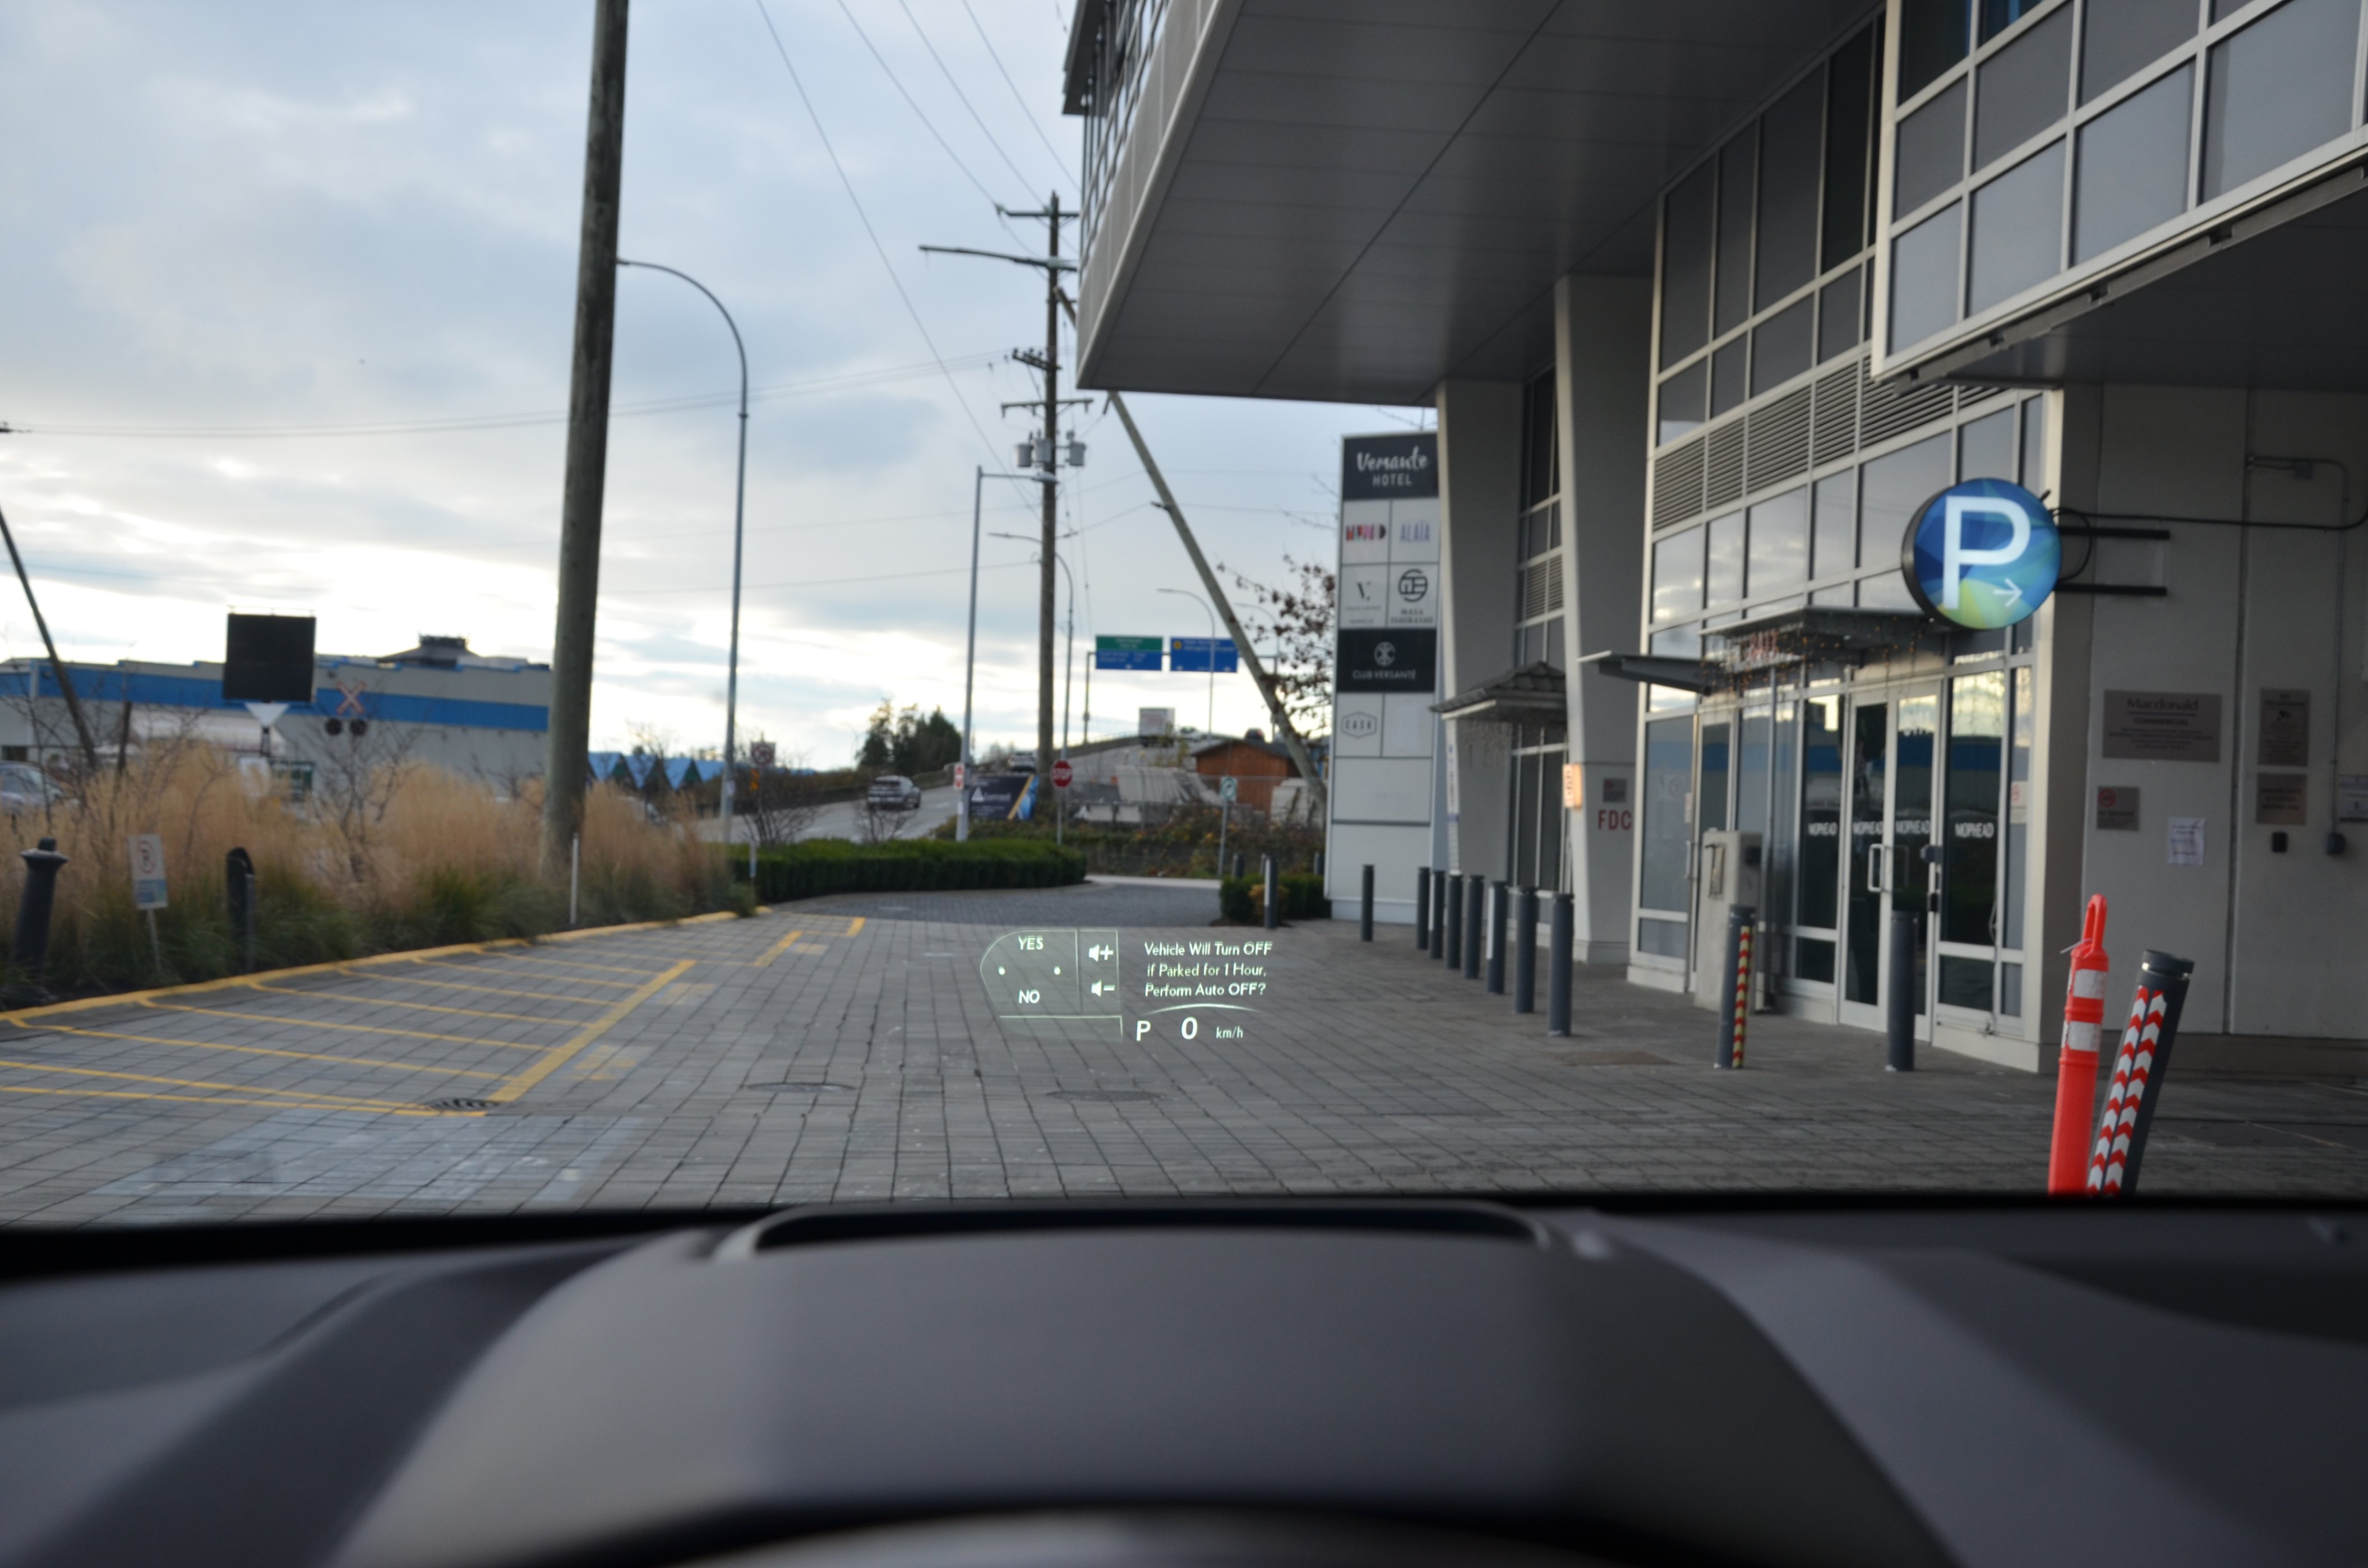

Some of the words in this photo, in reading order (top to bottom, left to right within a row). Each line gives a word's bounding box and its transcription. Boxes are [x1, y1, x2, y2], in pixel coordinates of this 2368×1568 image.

[1372, 473, 1413, 487] HOTEL
[1942, 495, 2031, 610] P
[1352, 670, 1373, 680] CLUB
[2126, 698, 2199, 710] Macdonald
[1346, 719, 1372, 729] CASK
[1051, 767, 1072, 780] STOP
[1598, 809, 1633, 831] FDC
[1018, 936, 1044, 951] YES
[1144, 942, 1185, 956] Vehicle
[1189, 942, 1211, 956] Will
[1214, 942, 1240, 956] Turn
[1243, 941, 1273, 955] OFF
[1147, 963, 1156, 977] if
[1158, 963, 1199, 977] Parked
[1203, 963, 1220, 977] for
[1224, 963, 1229, 976] 1
[1233, 963, 1266, 977] Hour,
[1018, 989, 1041, 1004] NO
[1144, 983, 1192, 997] Perform
[1194, 983, 1225, 996] Auto
[1228, 982, 1266, 996] OFF?
[1136, 1020, 1151, 1042] P
[1181, 1016, 1198, 1040] 0
[1216, 1026, 1244, 1039] km/h
